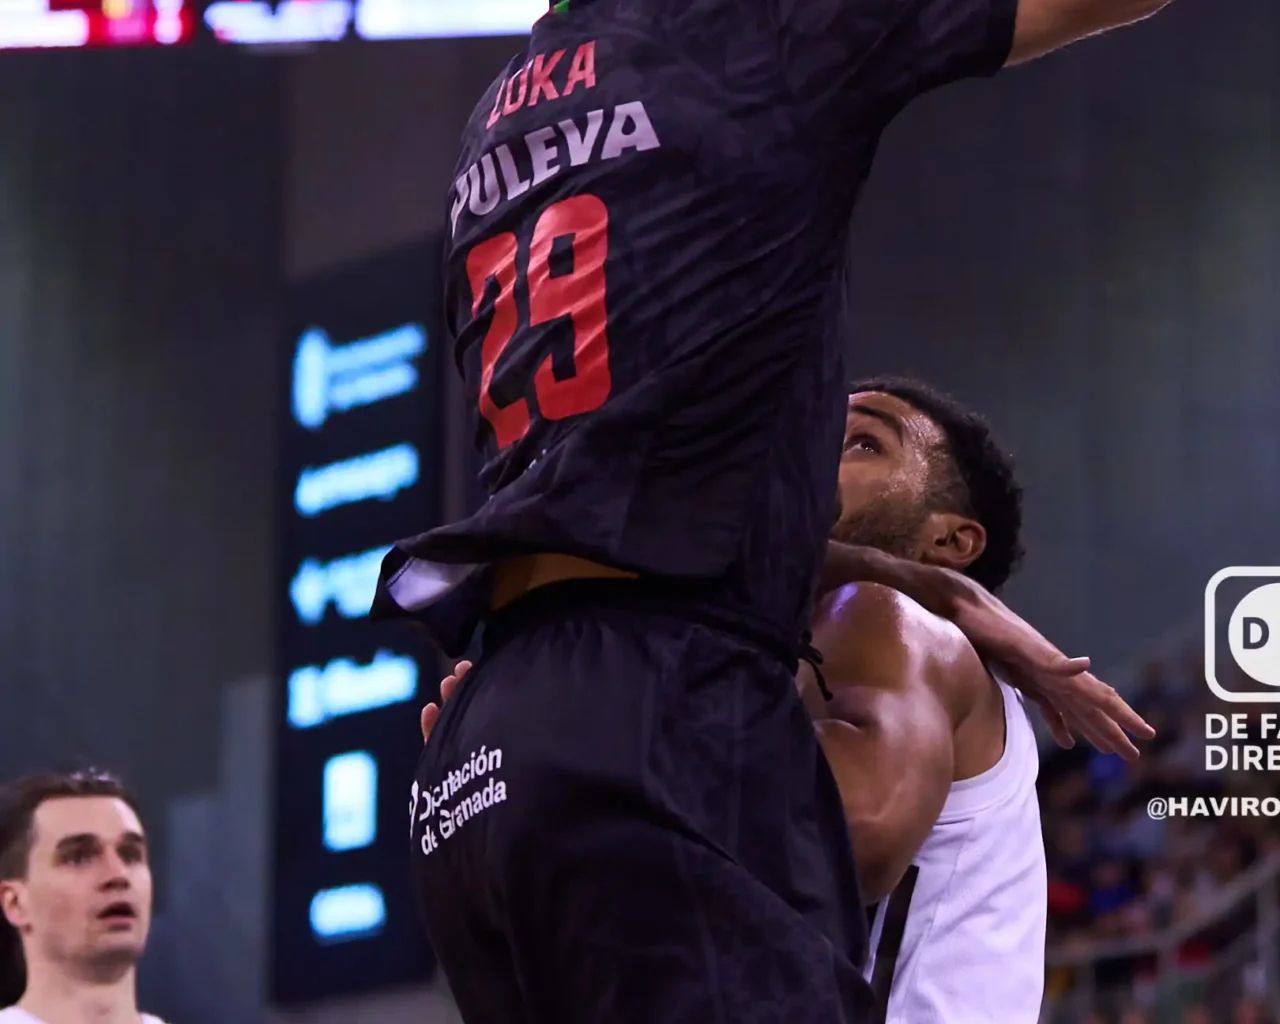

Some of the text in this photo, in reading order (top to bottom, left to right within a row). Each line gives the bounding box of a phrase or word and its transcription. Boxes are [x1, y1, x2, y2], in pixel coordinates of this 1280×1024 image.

[451, 101, 661, 239] PULEVA
[466, 193, 612, 450] 29
[439, 777, 508, 840] Granada
